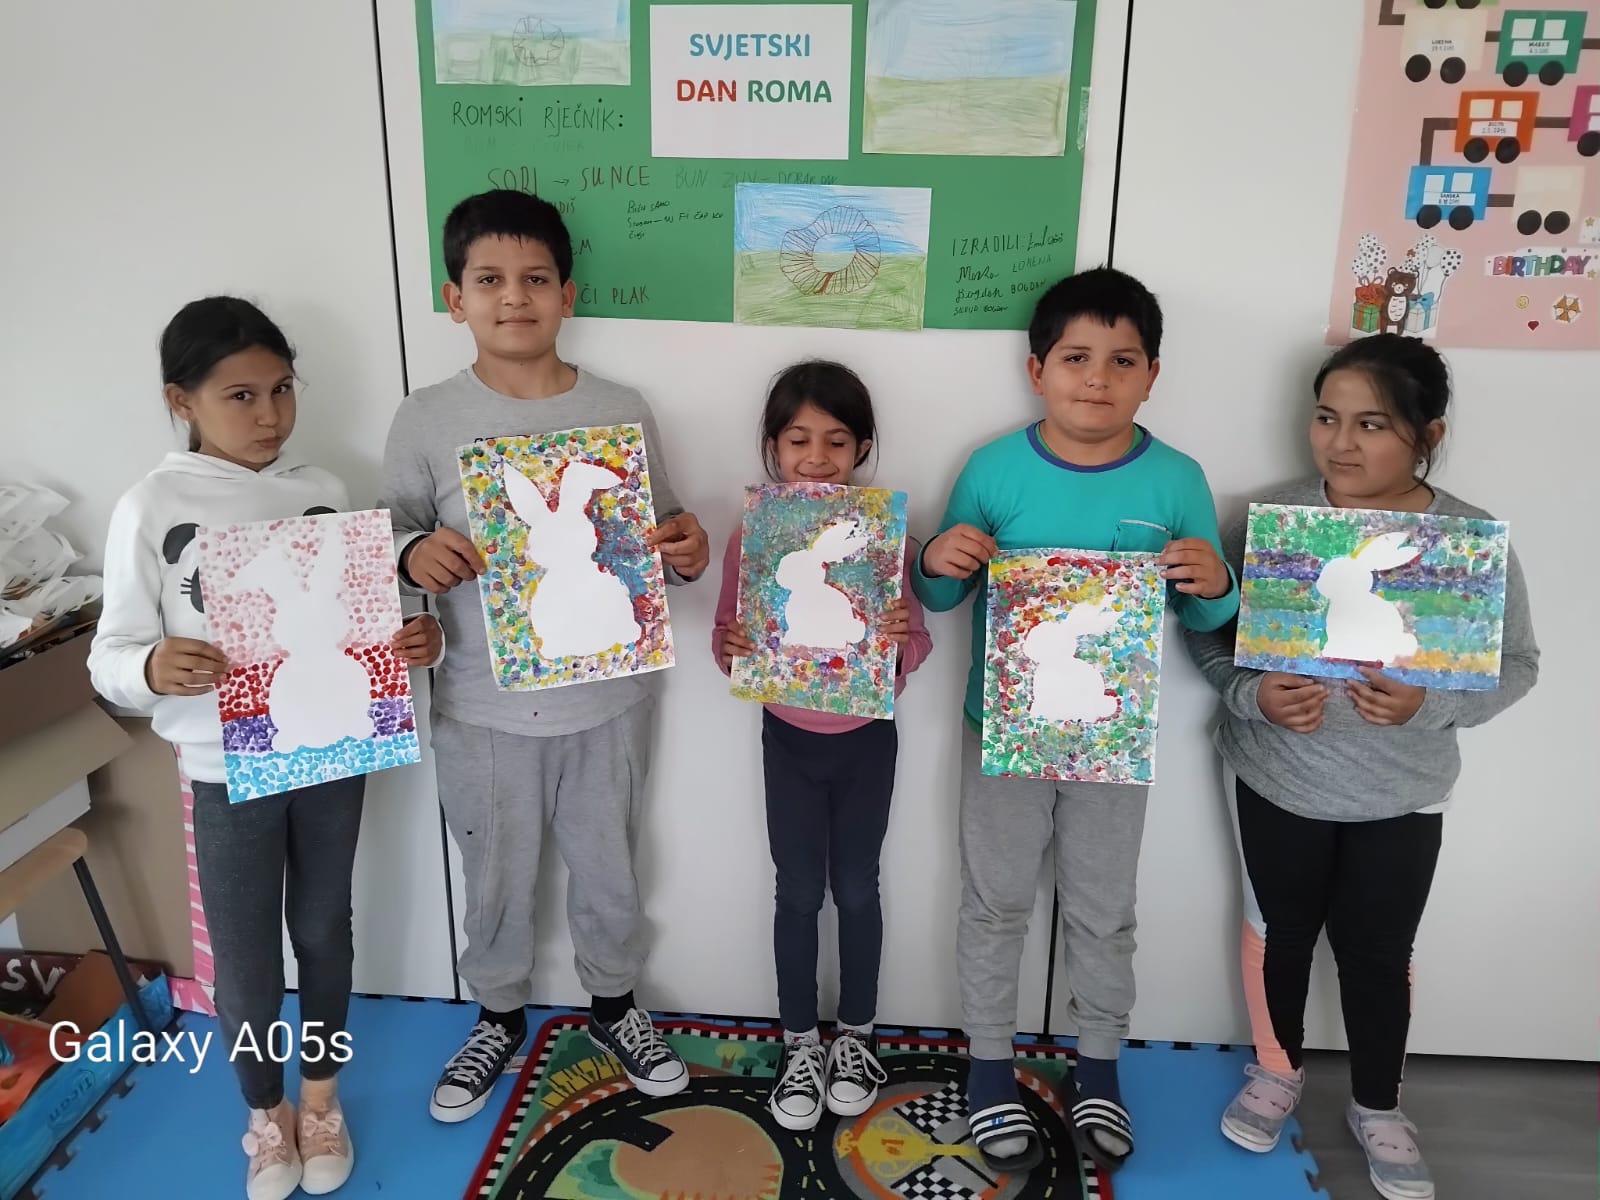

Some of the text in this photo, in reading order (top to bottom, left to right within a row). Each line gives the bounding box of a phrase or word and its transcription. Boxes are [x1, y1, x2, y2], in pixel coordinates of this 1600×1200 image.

[689, 33, 810, 61] SVJETSKI
[676, 79, 832, 103] DAN ROMA
[453, 97, 524, 127] ROMSKI
[581, 166, 651, 191] SUNCE
[1493, 255, 1591, 277] BIRTHDAY
[612, 285, 650, 305] PLAK
